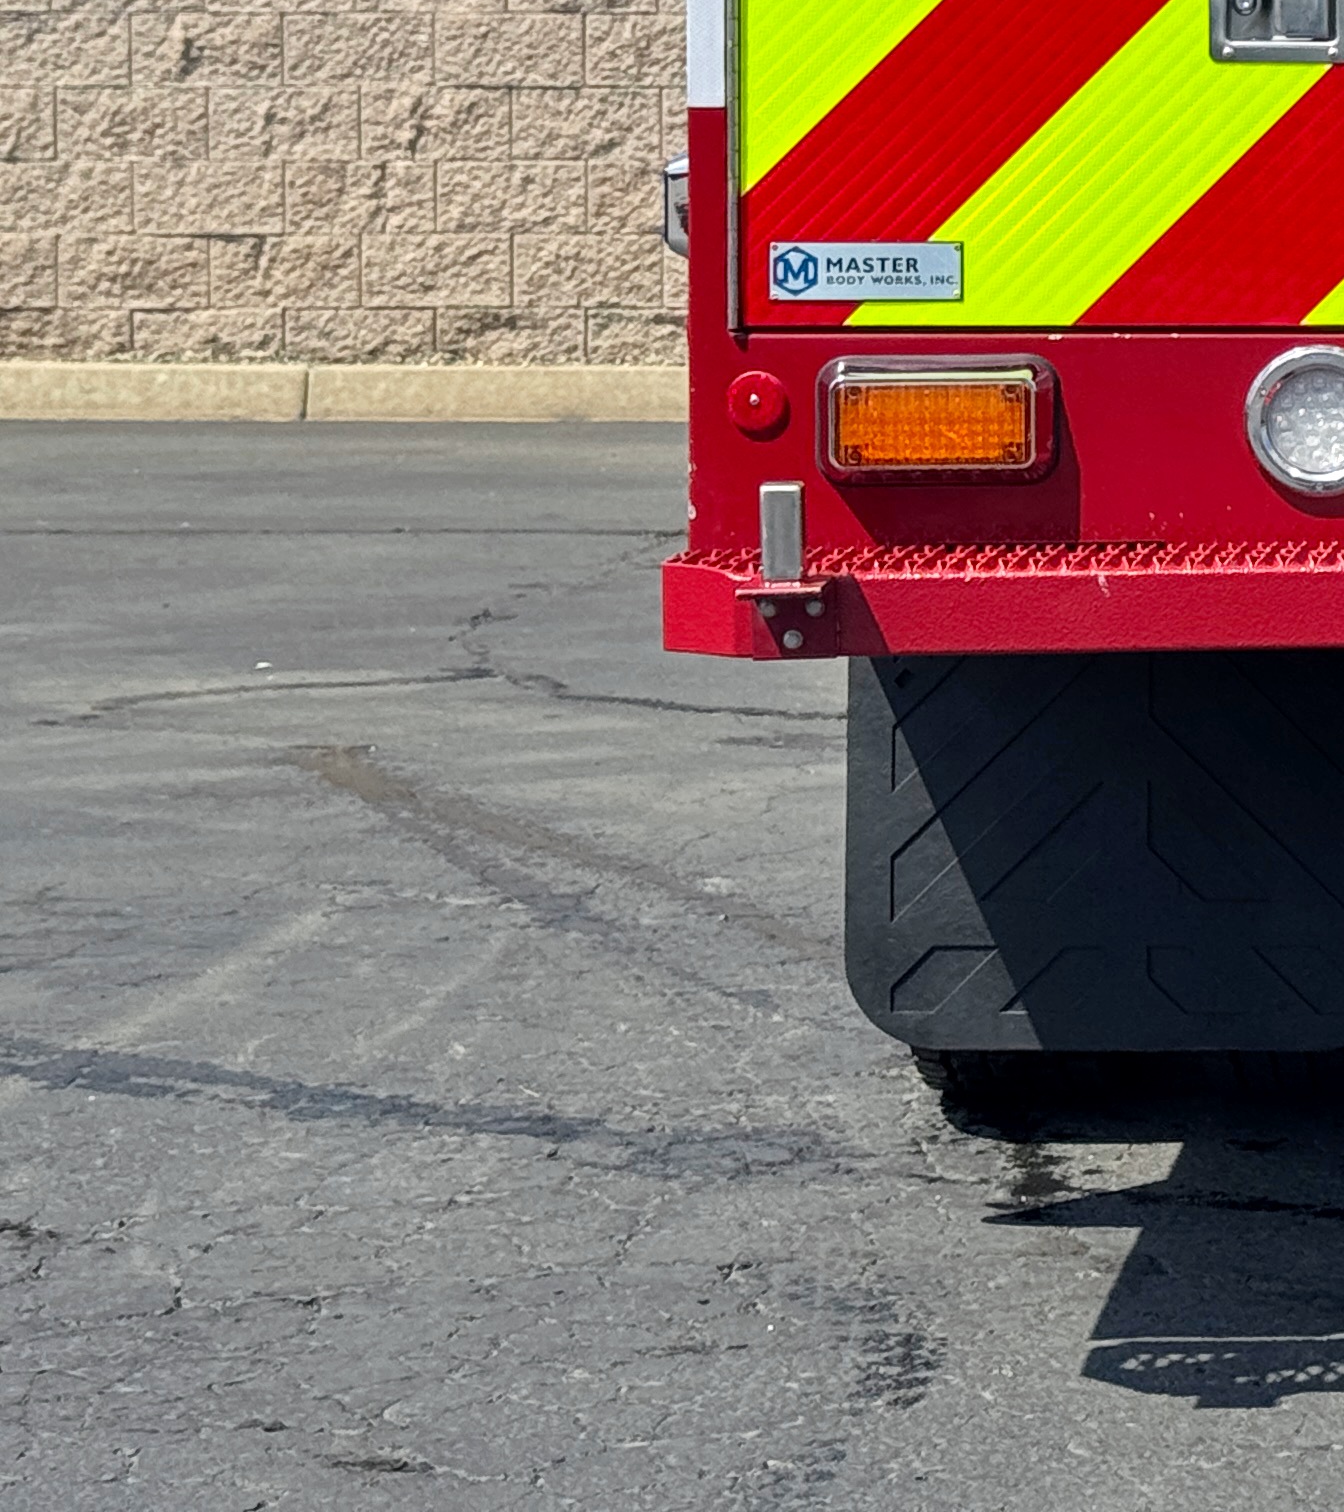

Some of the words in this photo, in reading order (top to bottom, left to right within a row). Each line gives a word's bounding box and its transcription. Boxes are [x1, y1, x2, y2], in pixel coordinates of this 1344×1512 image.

[826, 257, 919, 273] MASTER
[826, 275, 865, 285] BODY
[870, 275, 927, 287] WORKS,
[930, 275, 958, 285] INC.
